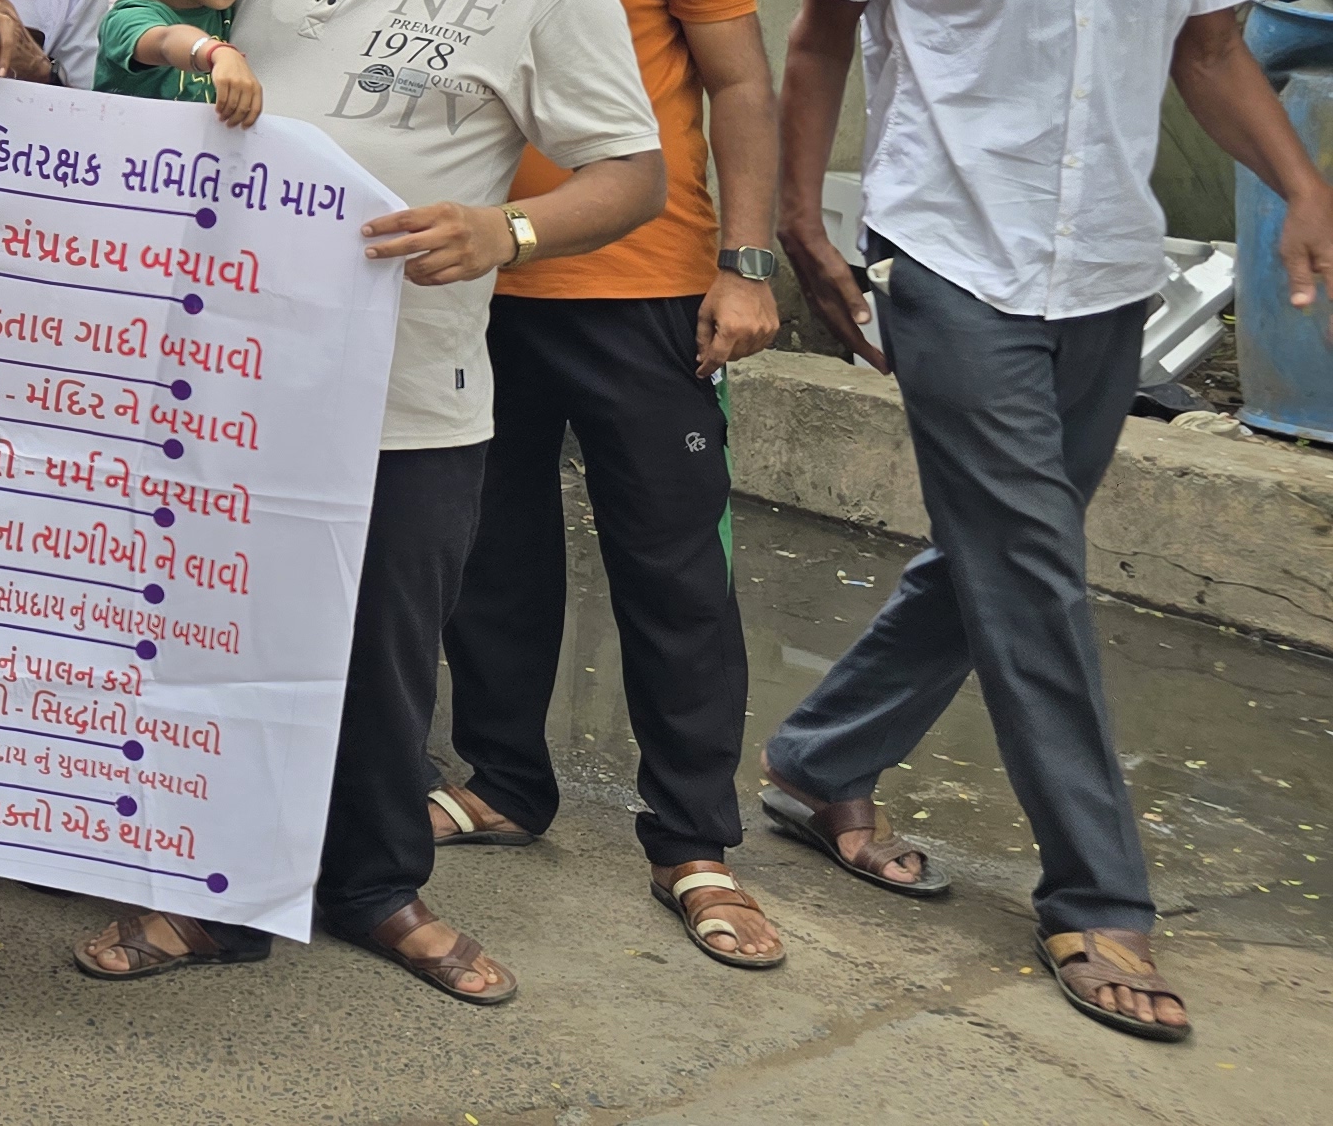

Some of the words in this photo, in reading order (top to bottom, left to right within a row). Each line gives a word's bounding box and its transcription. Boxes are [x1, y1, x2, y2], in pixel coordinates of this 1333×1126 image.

[360, 29, 455, 71] 1978
[389, 18, 472, 46] PREMIUM
[398, 78, 424, 88] DENIM
[121, 149, 221, 202] સમિતિ
[231, 163, 269, 211] ની
[280, 178, 345, 220] માગ
[32, 522, 146, 575] ત્યાગીઓ
[154, 535, 176, 581] ને
[184, 551, 249, 595] લાવો
[70, 593, 87, 631] નું
[91, 597, 166, 641] બંધારણ
[172, 621, 240, 655] બચાવો
[26, 654, 95, 689] પાલન
[101, 664, 143, 697] કરો
[61, 806, 110, 843] એક
[118, 825, 195, 860] થાઓ
